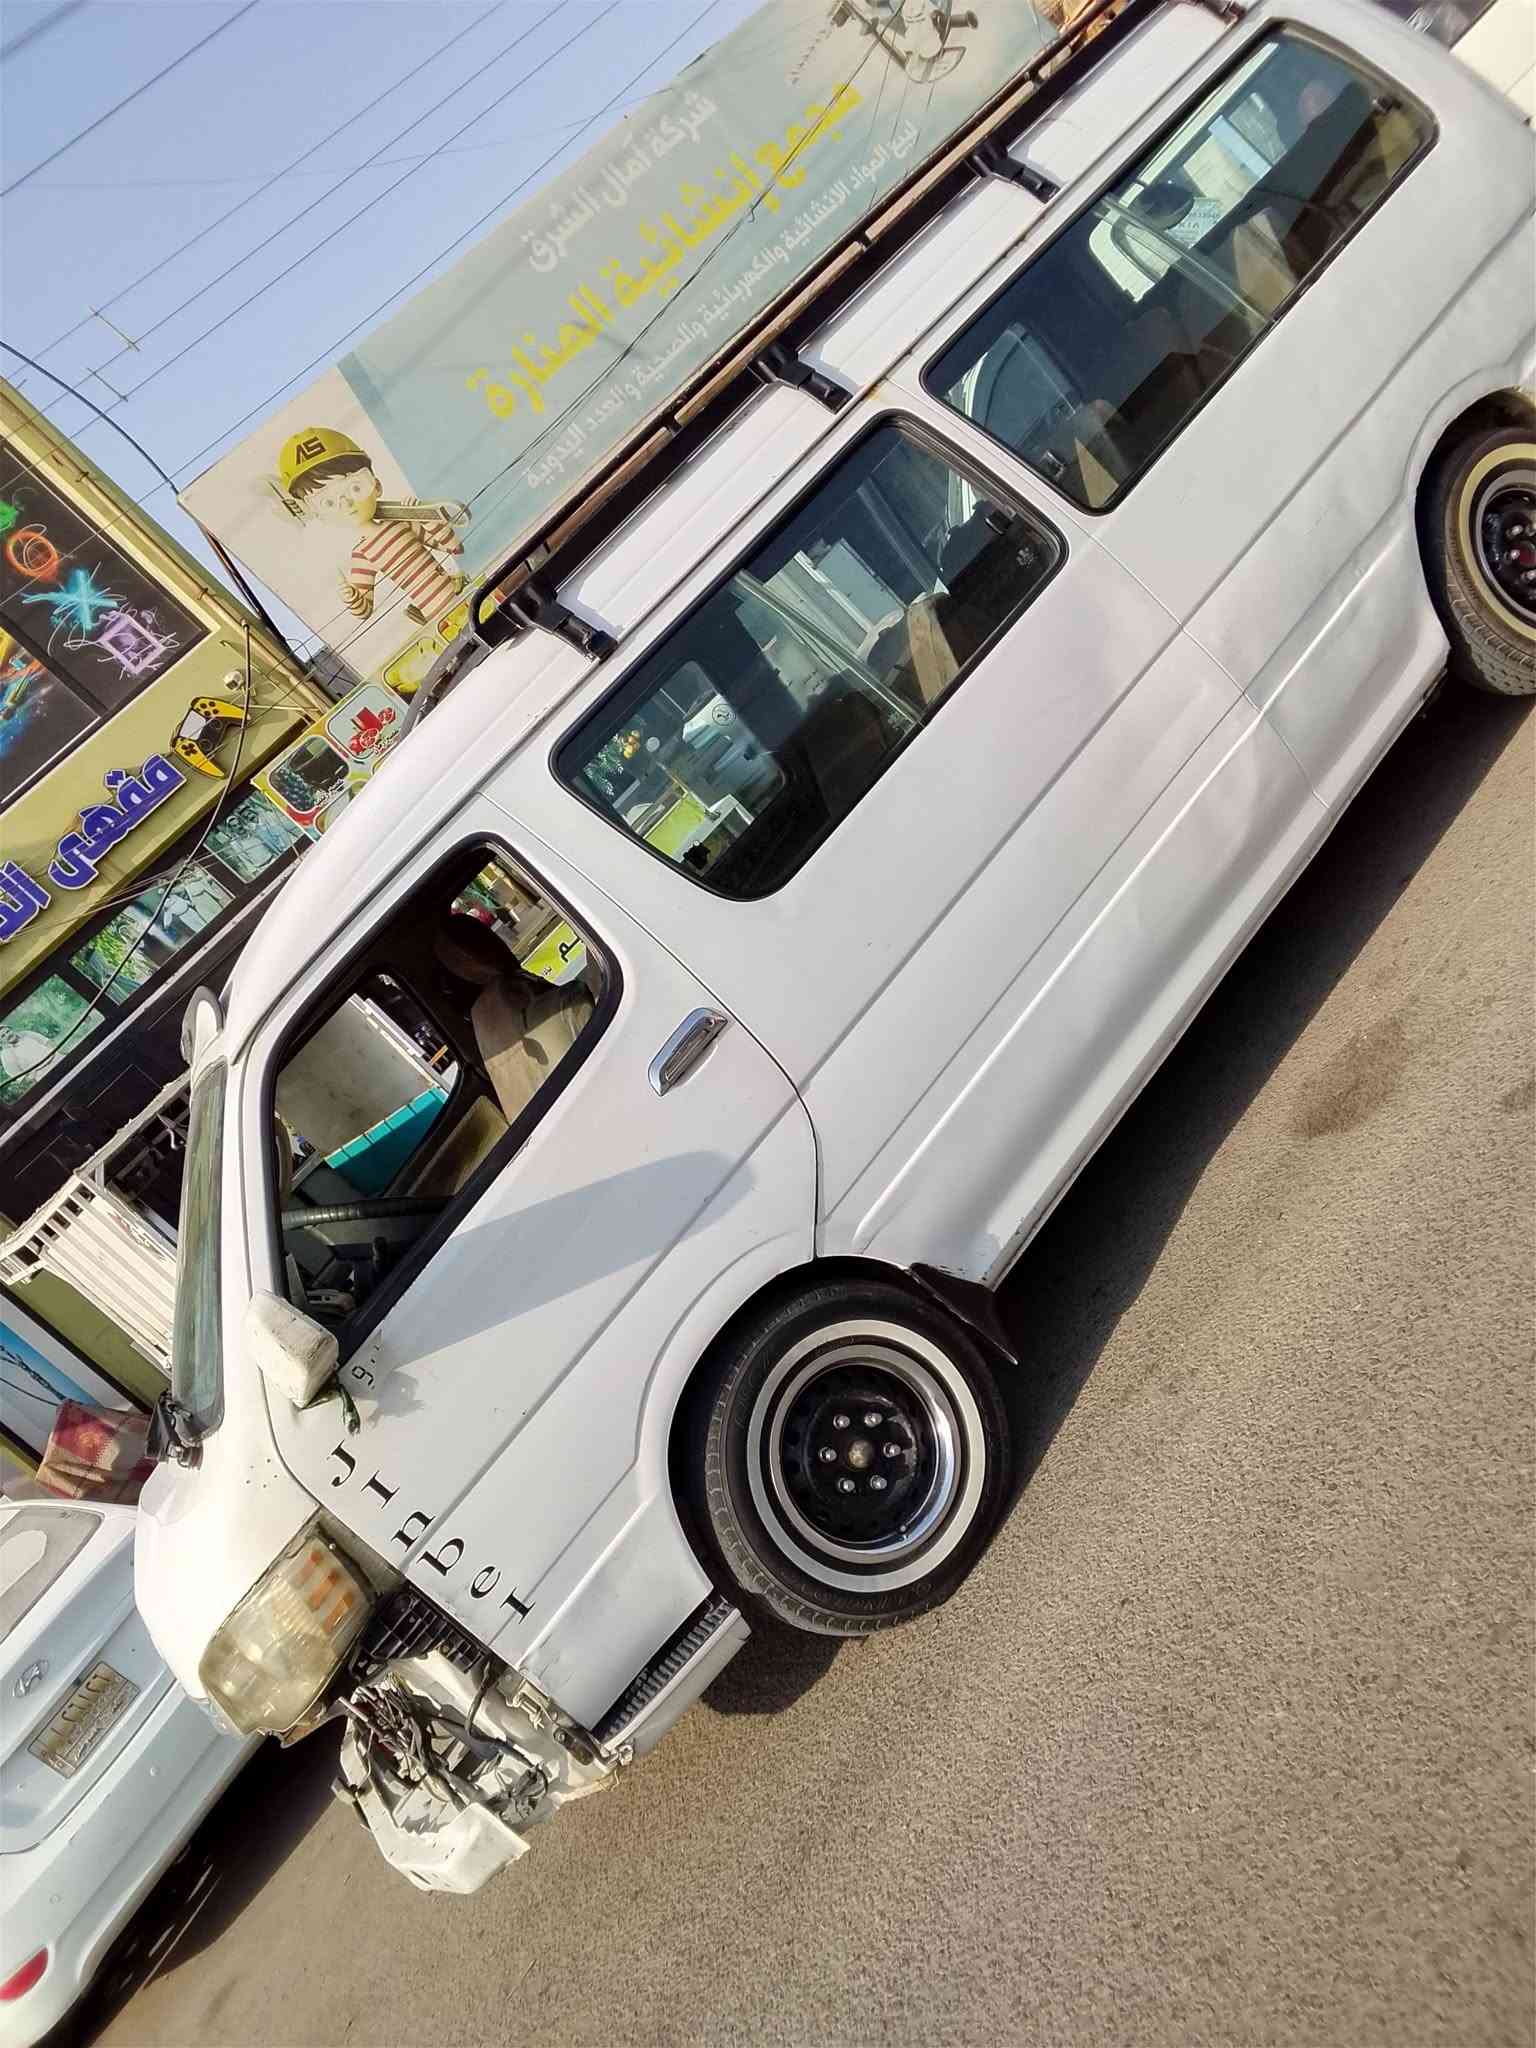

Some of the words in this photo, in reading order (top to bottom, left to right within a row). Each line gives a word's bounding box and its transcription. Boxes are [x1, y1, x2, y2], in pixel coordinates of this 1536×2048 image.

[648, 90, 718, 158] شركة
[755, 83, 863, 189] مجمع
[852, 144, 892, 189] المواد
[521, 187, 602, 272] الشرق
[465, 281, 615, 420] المنارة
[632, 320, 706, 384] والصحية
[585, 379, 642, 431] والعدد
